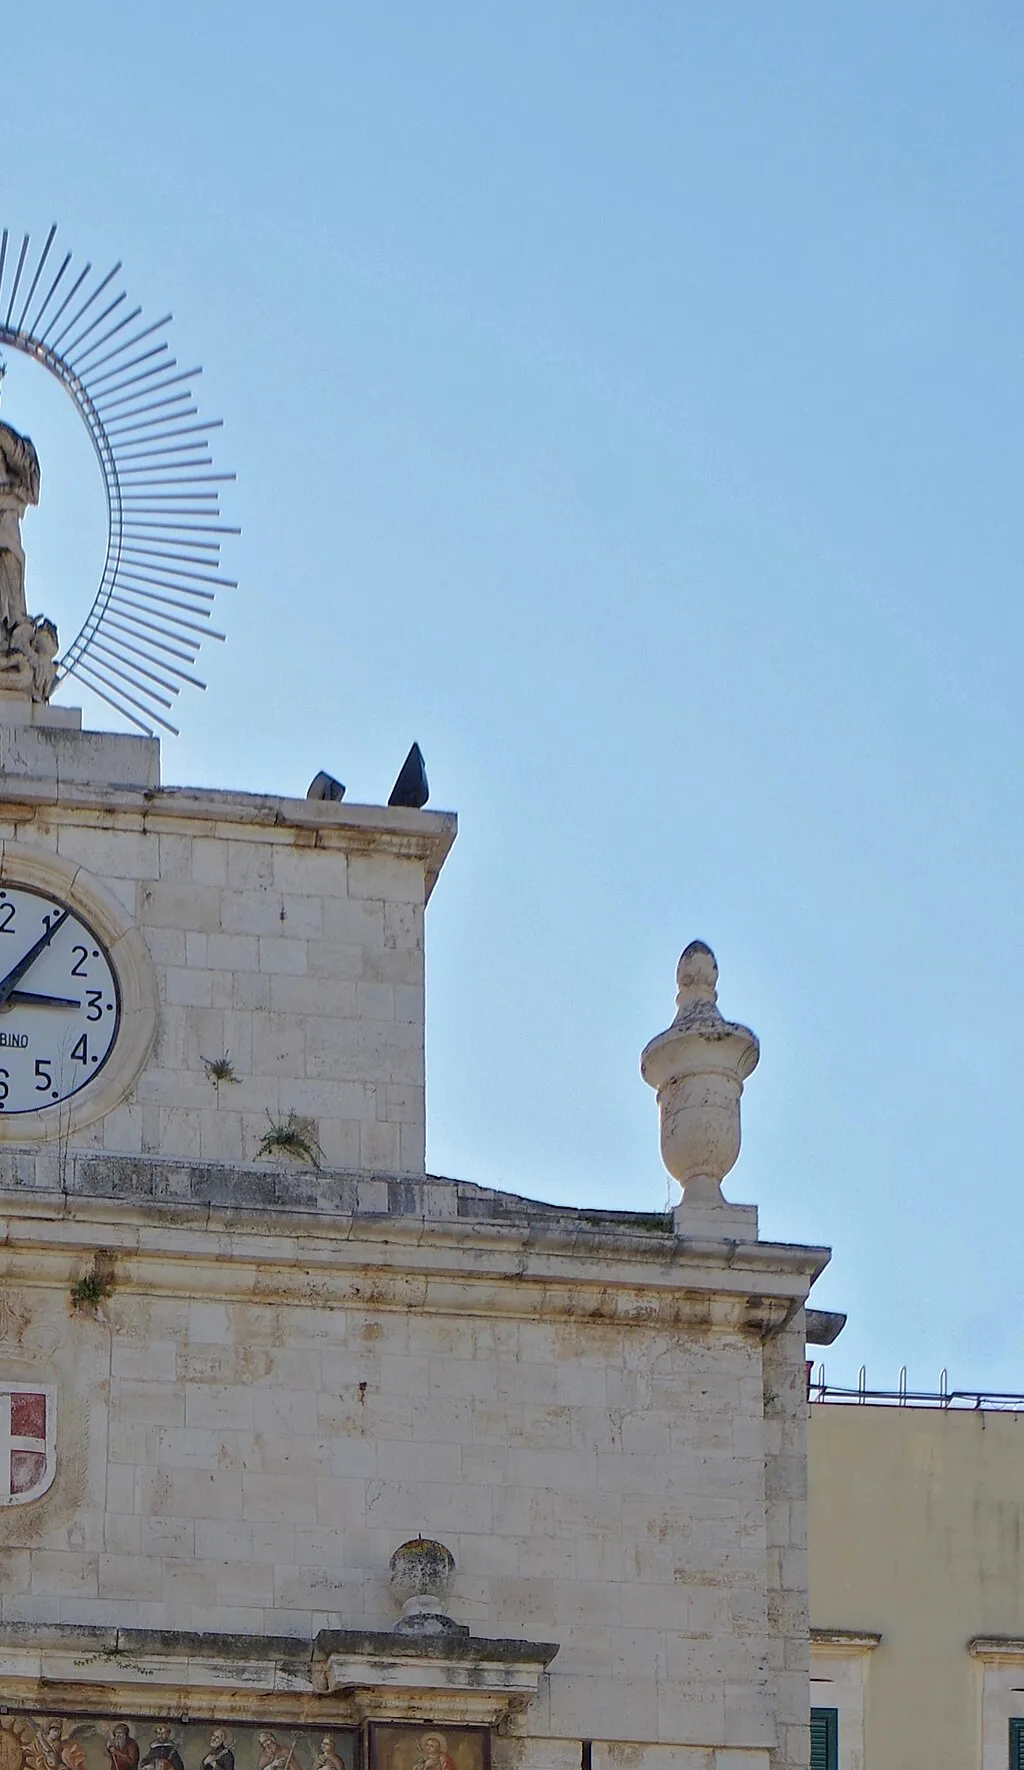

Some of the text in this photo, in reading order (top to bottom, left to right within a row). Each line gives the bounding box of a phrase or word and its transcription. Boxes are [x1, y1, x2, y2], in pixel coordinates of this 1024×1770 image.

[71, 945, 88, 977] 2
[85, 990, 103, 1022] 3
[70, 1033, 88, 1065] 4
[34, 1059, 52, 1092] 5
